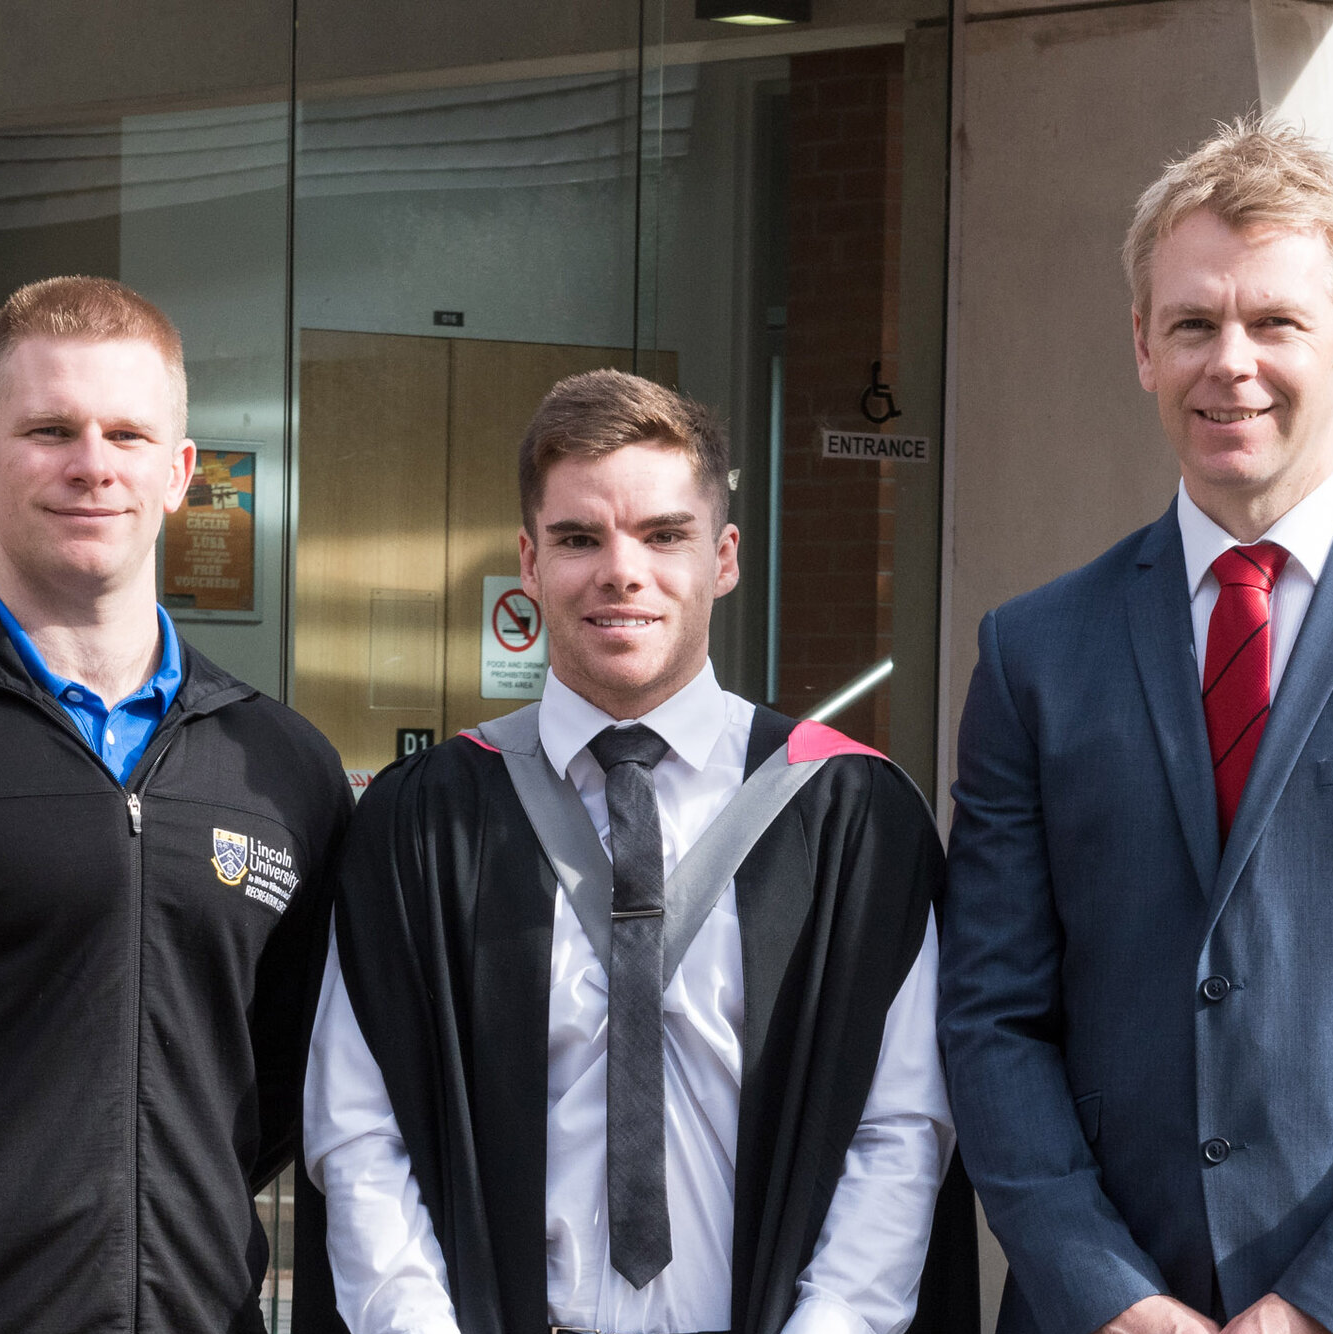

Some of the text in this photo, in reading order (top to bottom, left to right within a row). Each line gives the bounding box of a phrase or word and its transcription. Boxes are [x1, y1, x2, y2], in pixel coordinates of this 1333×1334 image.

[827, 435, 926, 459] ENTRANCE
[486, 660, 506, 669] FOOD
[508, 661, 521, 669] AND
[491, 671, 532, 679] PROHIBITED
[515, 681, 534, 689] AREA
[249, 837, 293, 869] Lincoln
[249, 854, 300, 894] University
